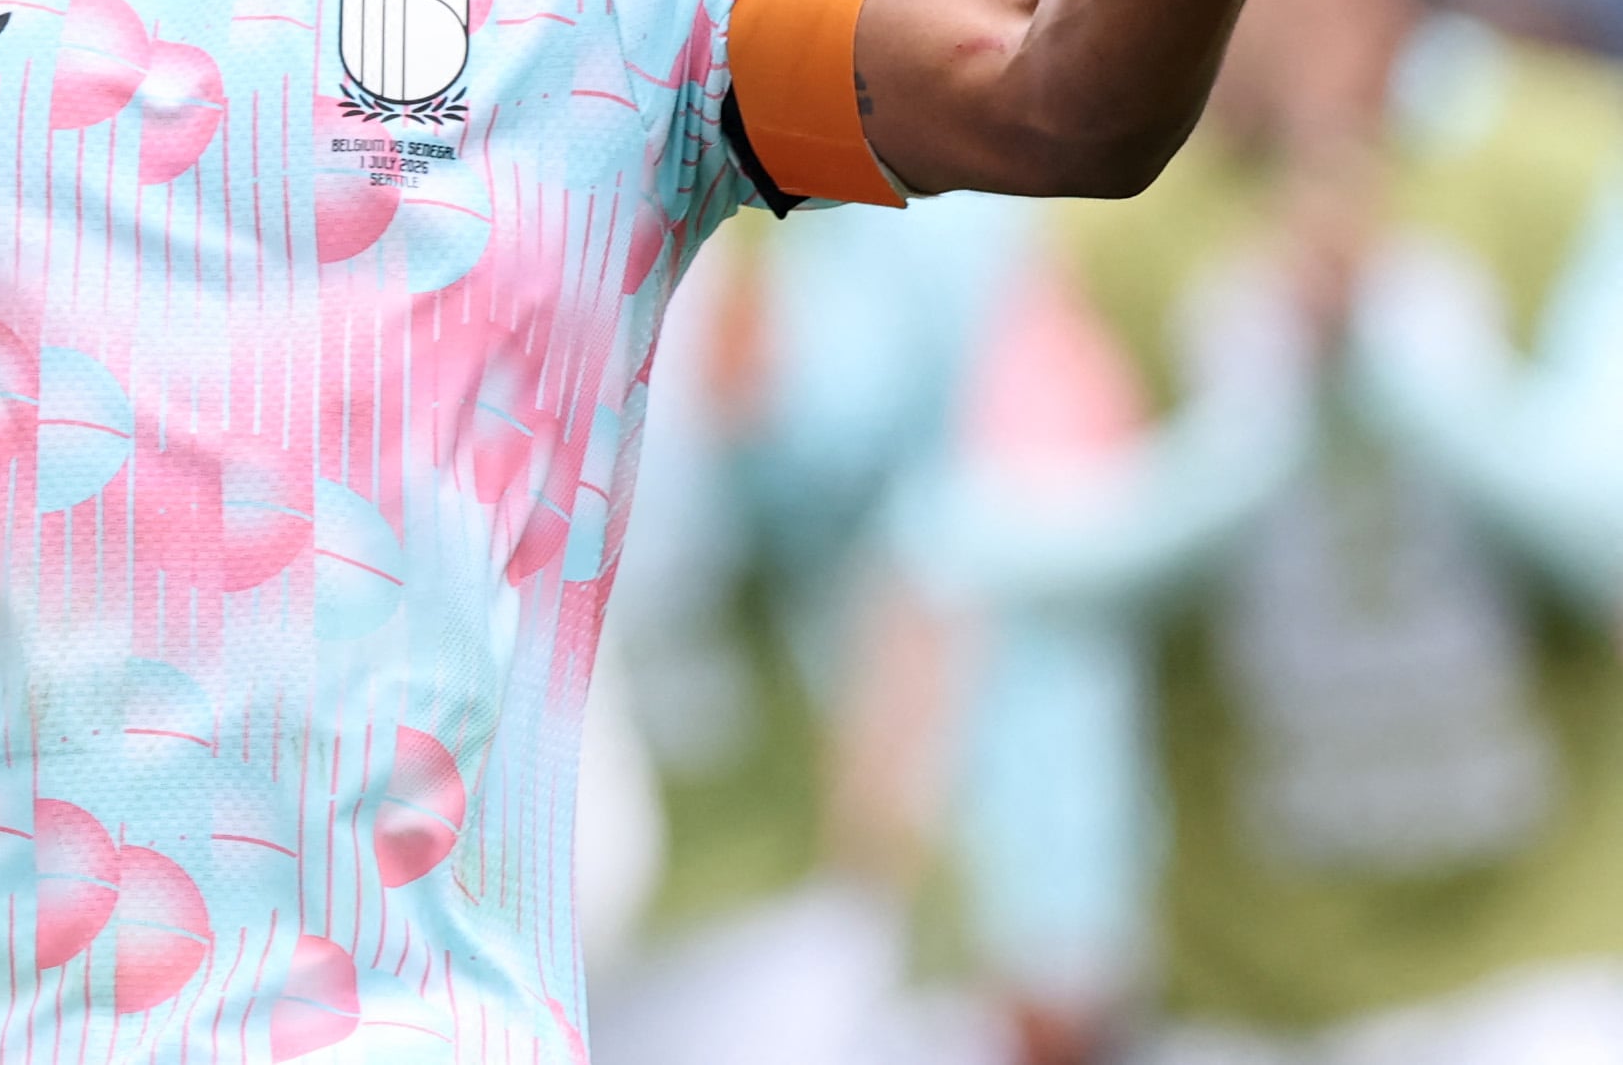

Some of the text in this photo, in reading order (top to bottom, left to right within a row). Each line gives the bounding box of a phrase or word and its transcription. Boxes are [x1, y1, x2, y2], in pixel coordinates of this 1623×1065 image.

[331, 138, 456, 160] BELGIUM VS SENEGAL
[360, 155, 429, 174] 1 JULY 2026
[370, 172, 420, 188] SEATTLE
